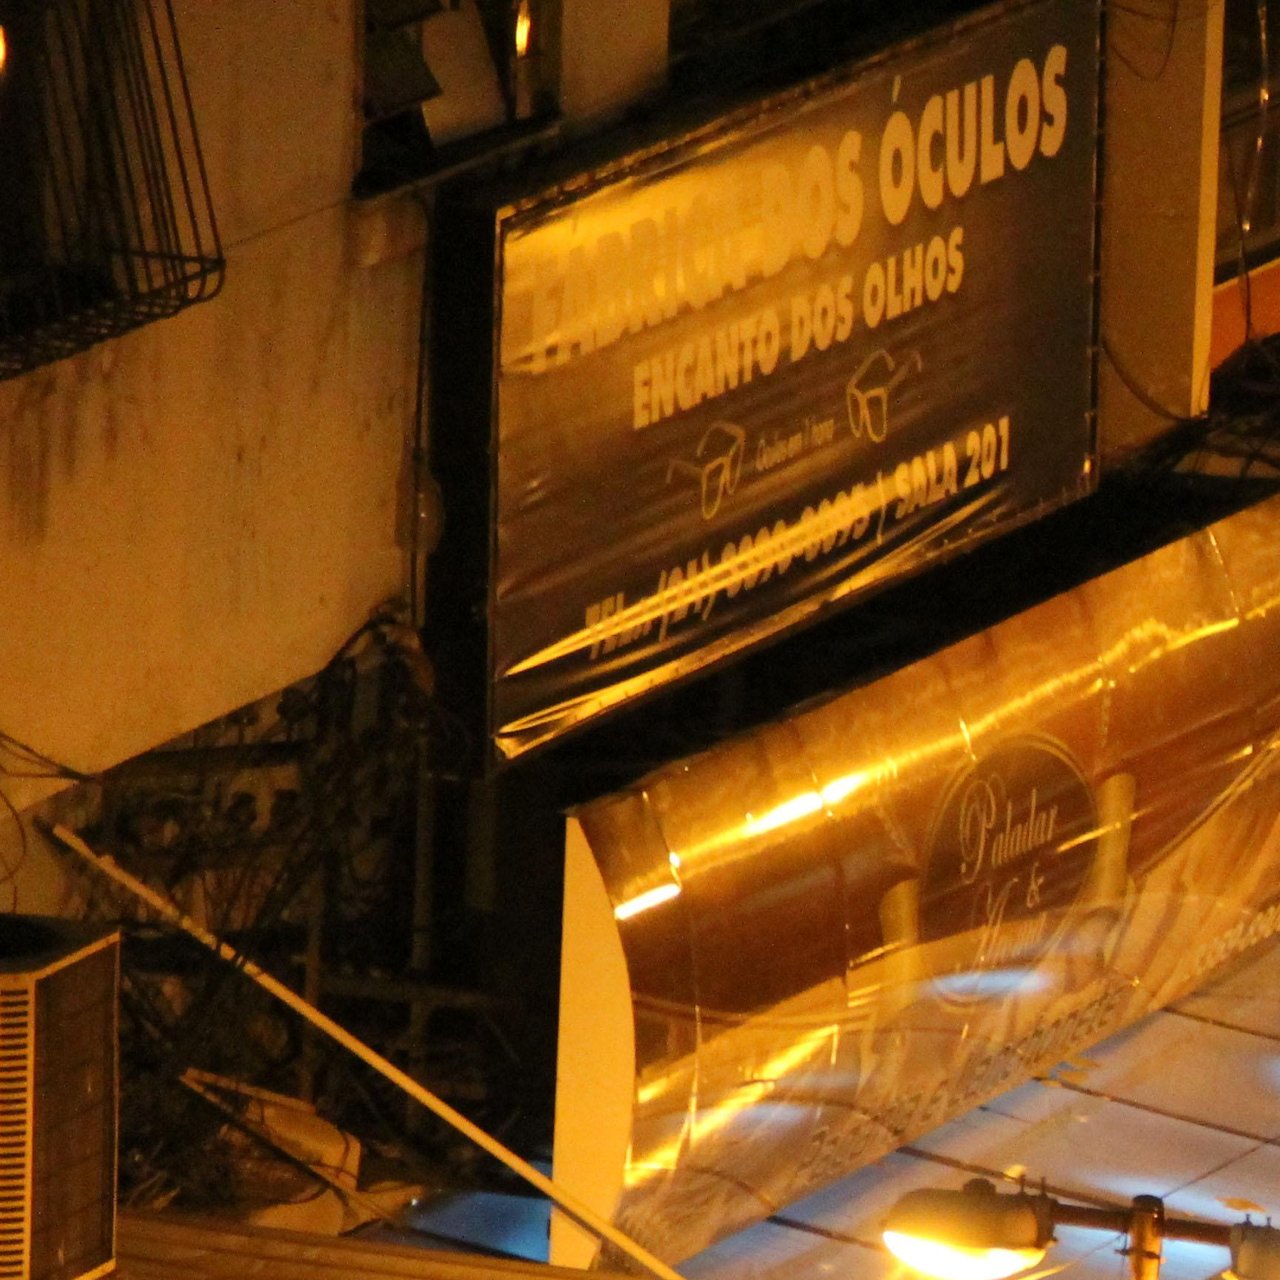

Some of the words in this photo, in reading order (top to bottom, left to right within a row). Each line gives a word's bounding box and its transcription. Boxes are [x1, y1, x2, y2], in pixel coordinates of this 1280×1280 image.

[758, 130, 865, 282] DOS
[879, 45, 1068, 226] ÓCULOS
[632, 310, 780, 430] ENCANTO
[791, 275, 853, 362] DOS
[863, 228, 964, 328] OLHOS
[895, 440, 957, 519] SALA
[963, 415, 1009, 489] 201
